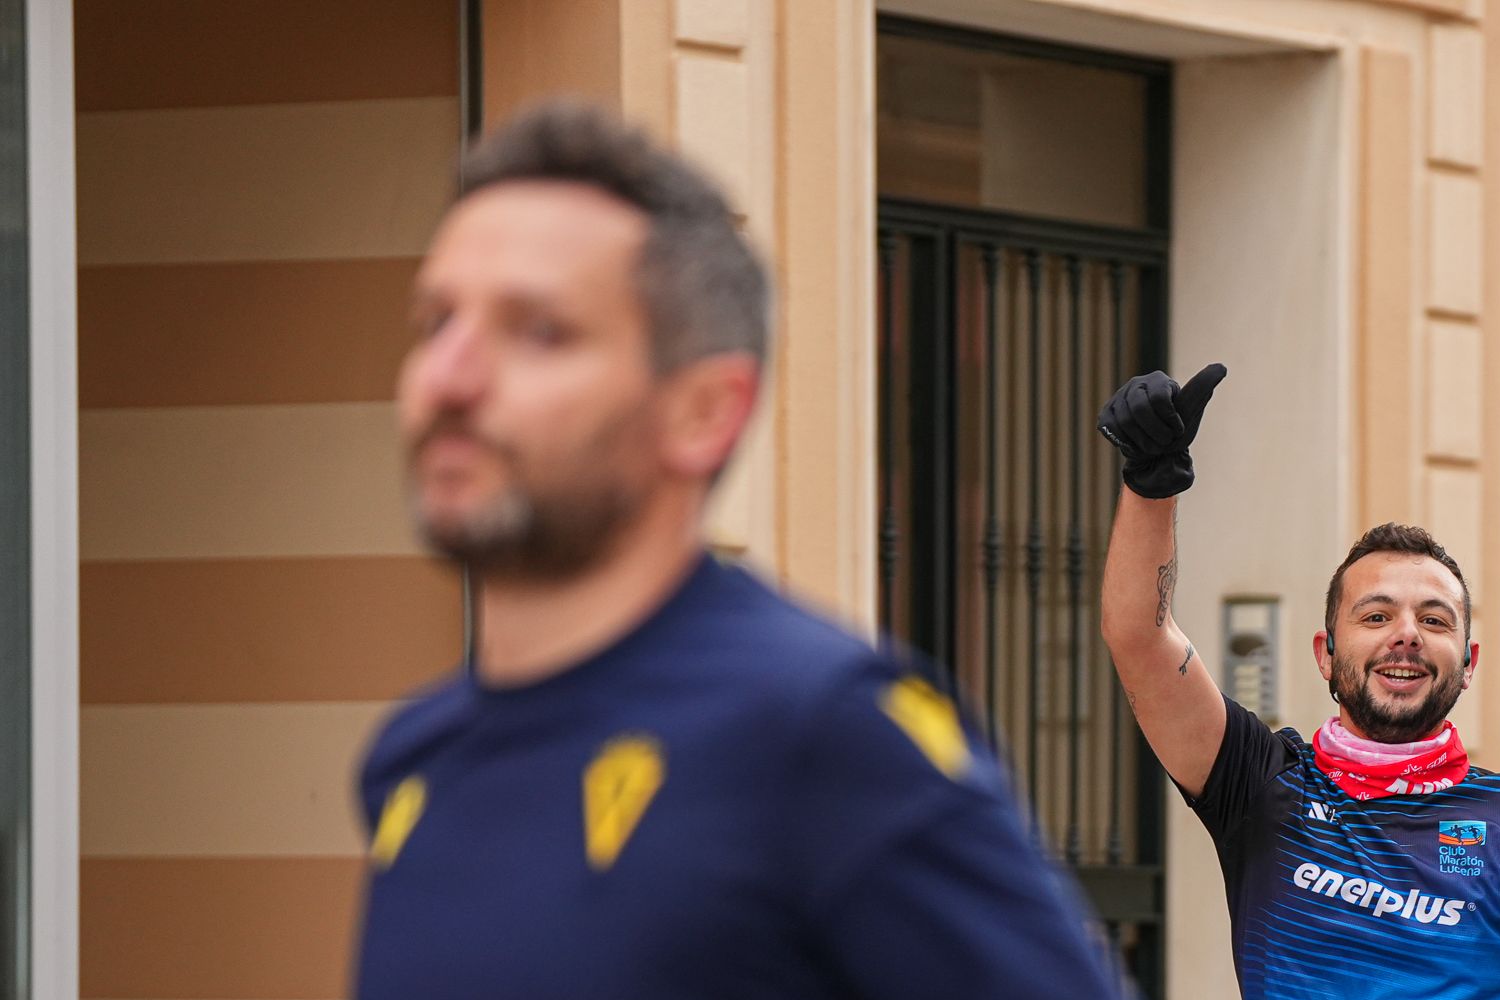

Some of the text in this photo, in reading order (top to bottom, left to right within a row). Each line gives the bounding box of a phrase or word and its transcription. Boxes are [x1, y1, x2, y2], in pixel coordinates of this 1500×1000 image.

[1439, 846, 1467, 856] Club
[1439, 854, 1485, 868] Maratón
[1439, 864, 1481, 877] Lucena
